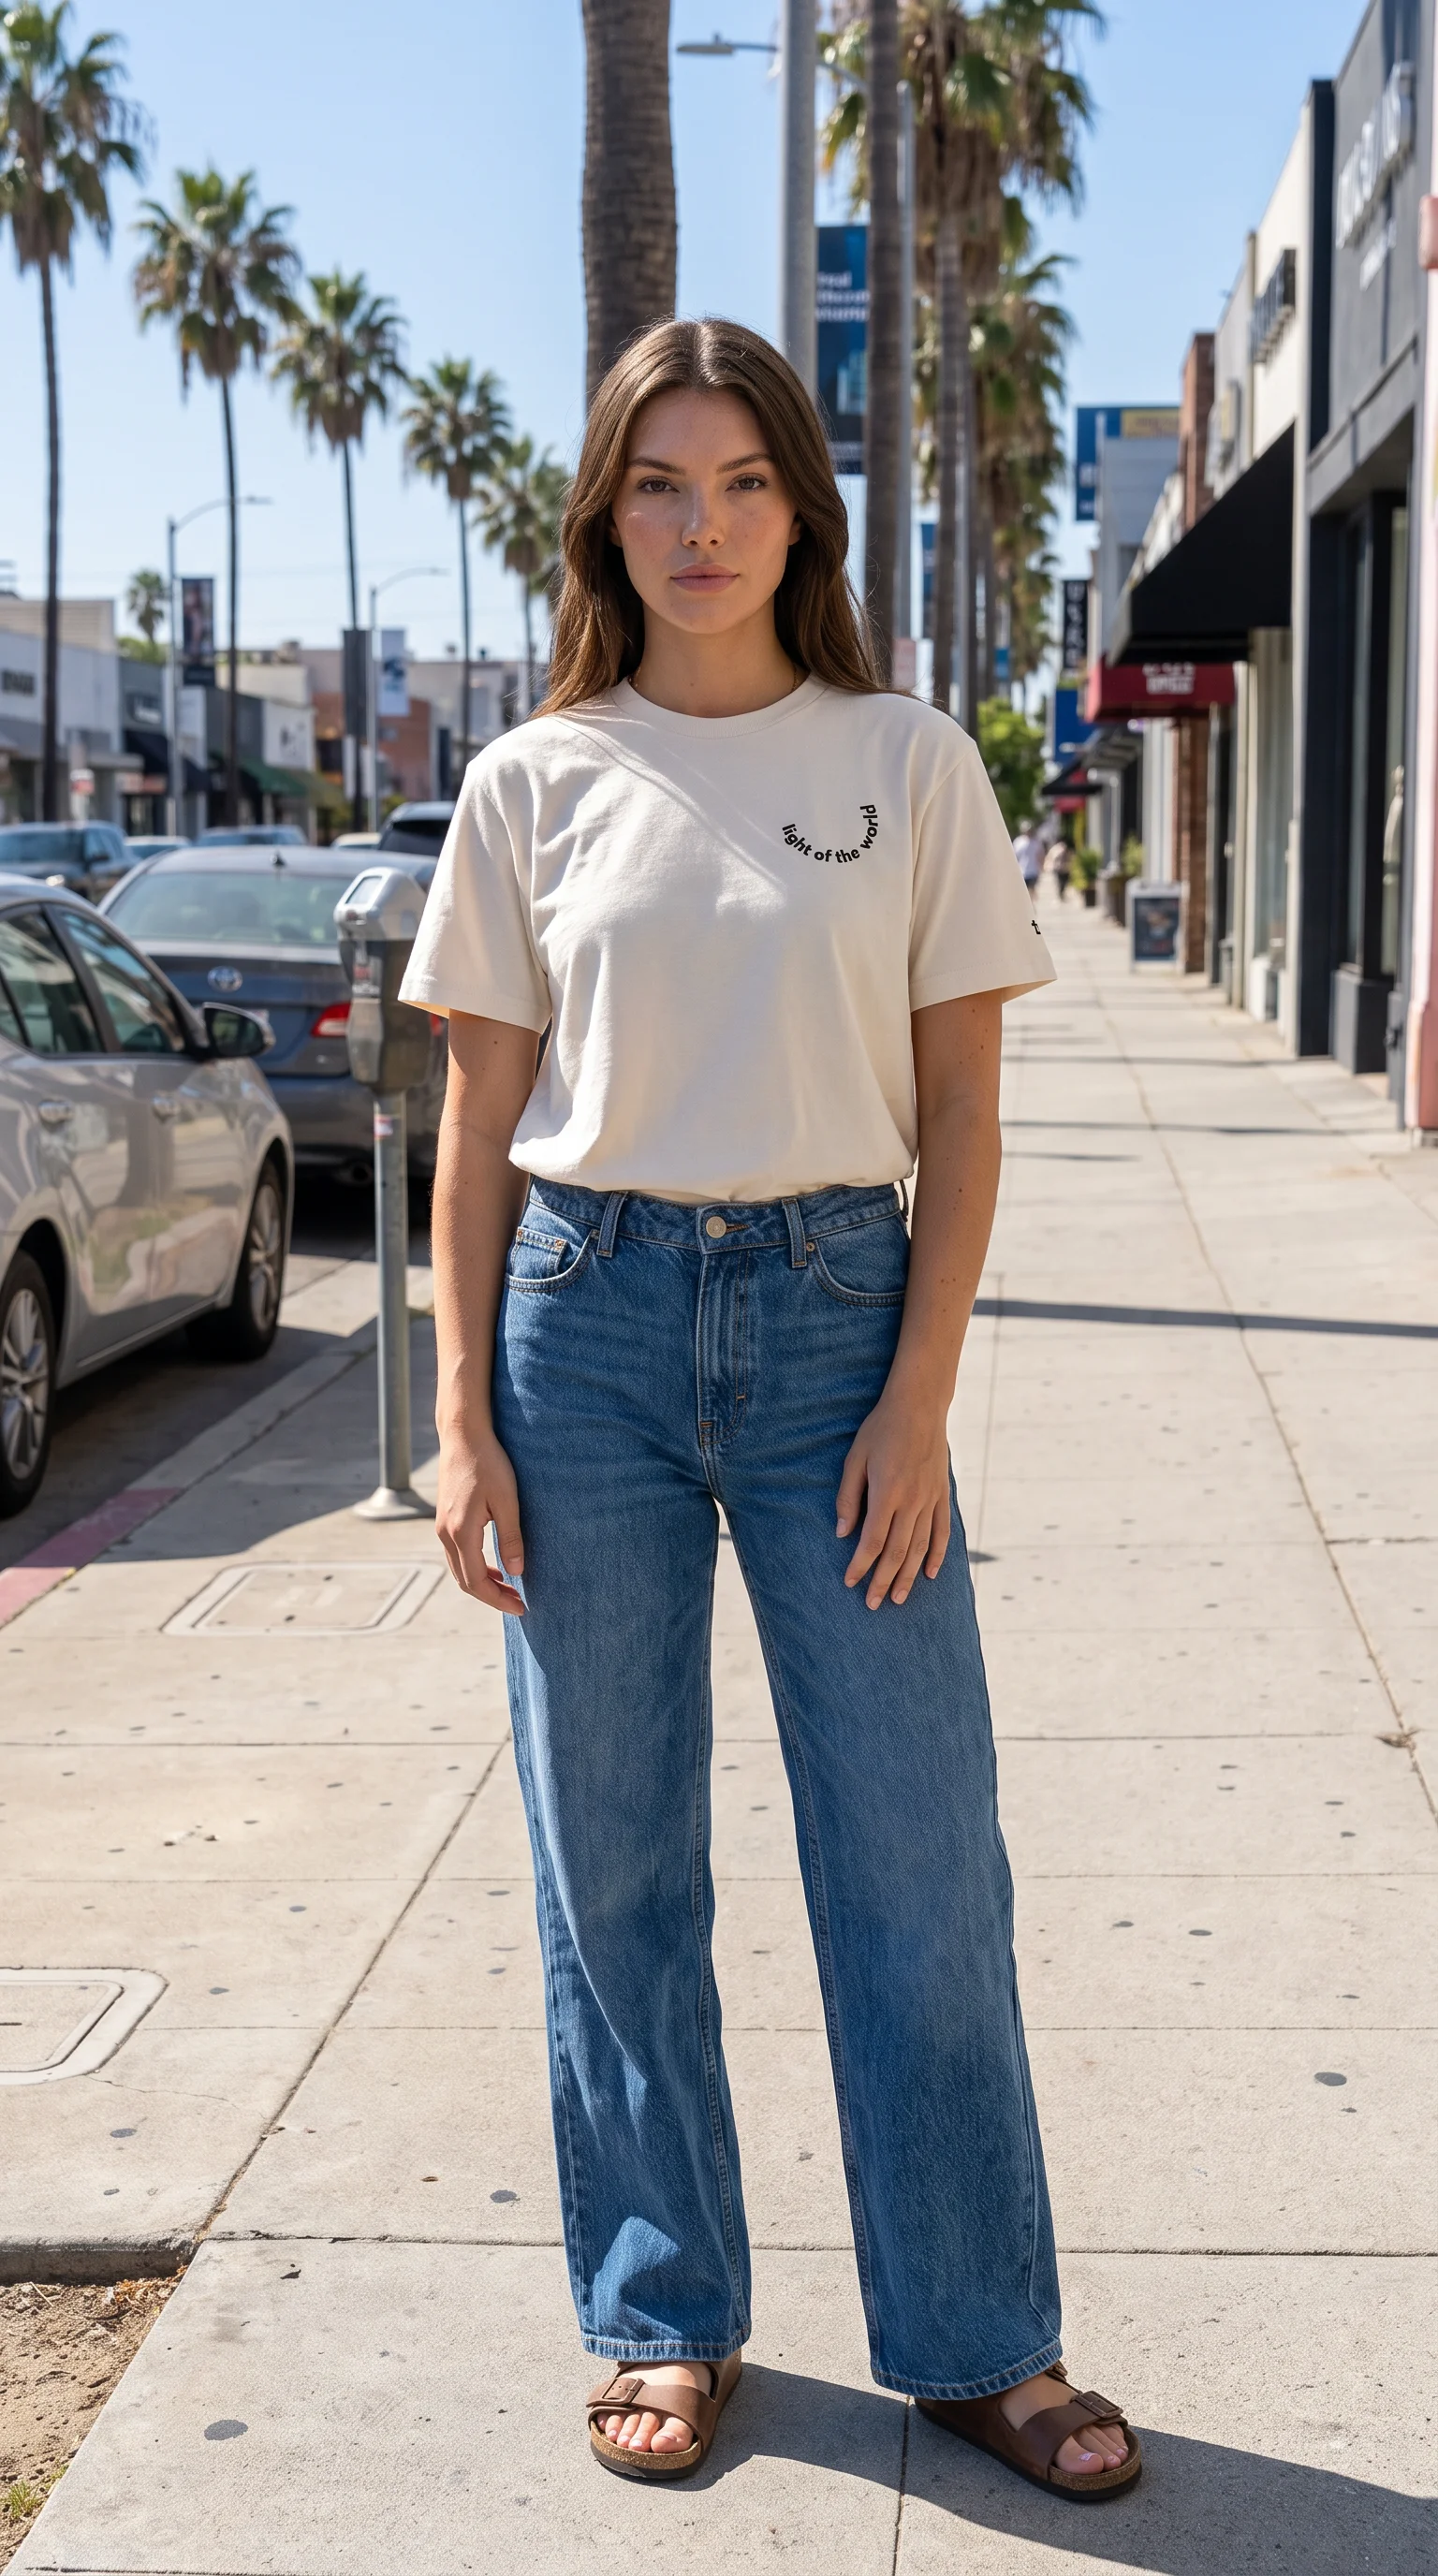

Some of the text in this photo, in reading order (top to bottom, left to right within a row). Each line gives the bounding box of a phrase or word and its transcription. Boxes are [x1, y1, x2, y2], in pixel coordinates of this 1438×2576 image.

[782, 804, 878, 863] light of the world
